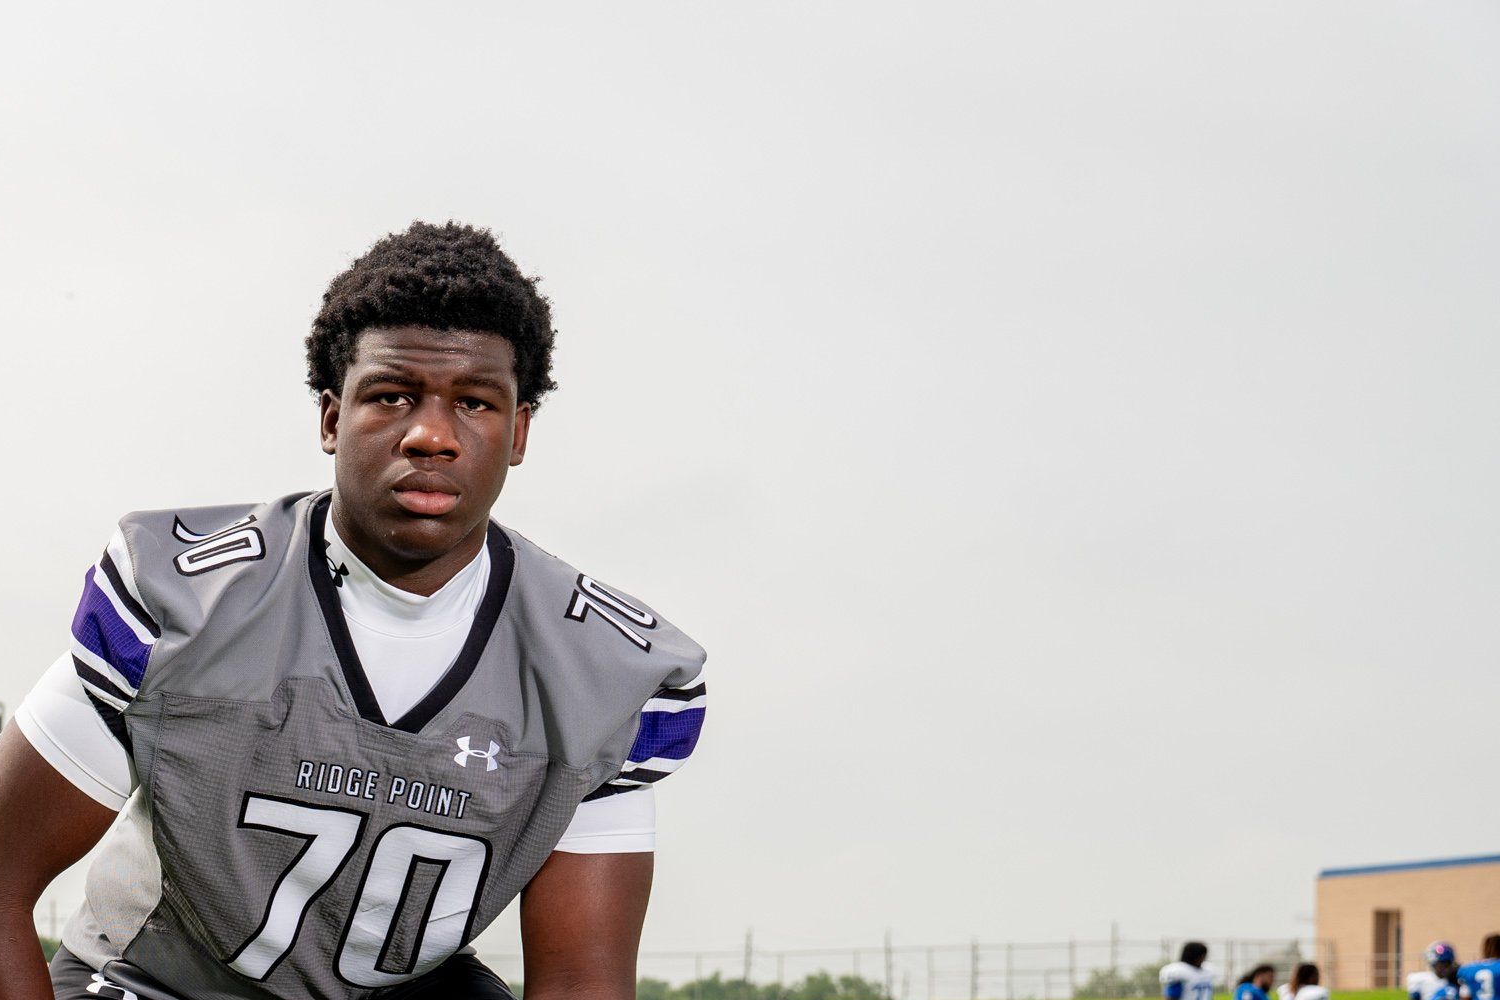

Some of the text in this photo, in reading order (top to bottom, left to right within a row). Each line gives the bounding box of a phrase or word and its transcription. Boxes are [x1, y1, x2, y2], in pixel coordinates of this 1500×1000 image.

[564, 573, 657, 653] 70
[296, 759, 471, 818] RIDGE POINT
[223, 791, 493, 988] 70
